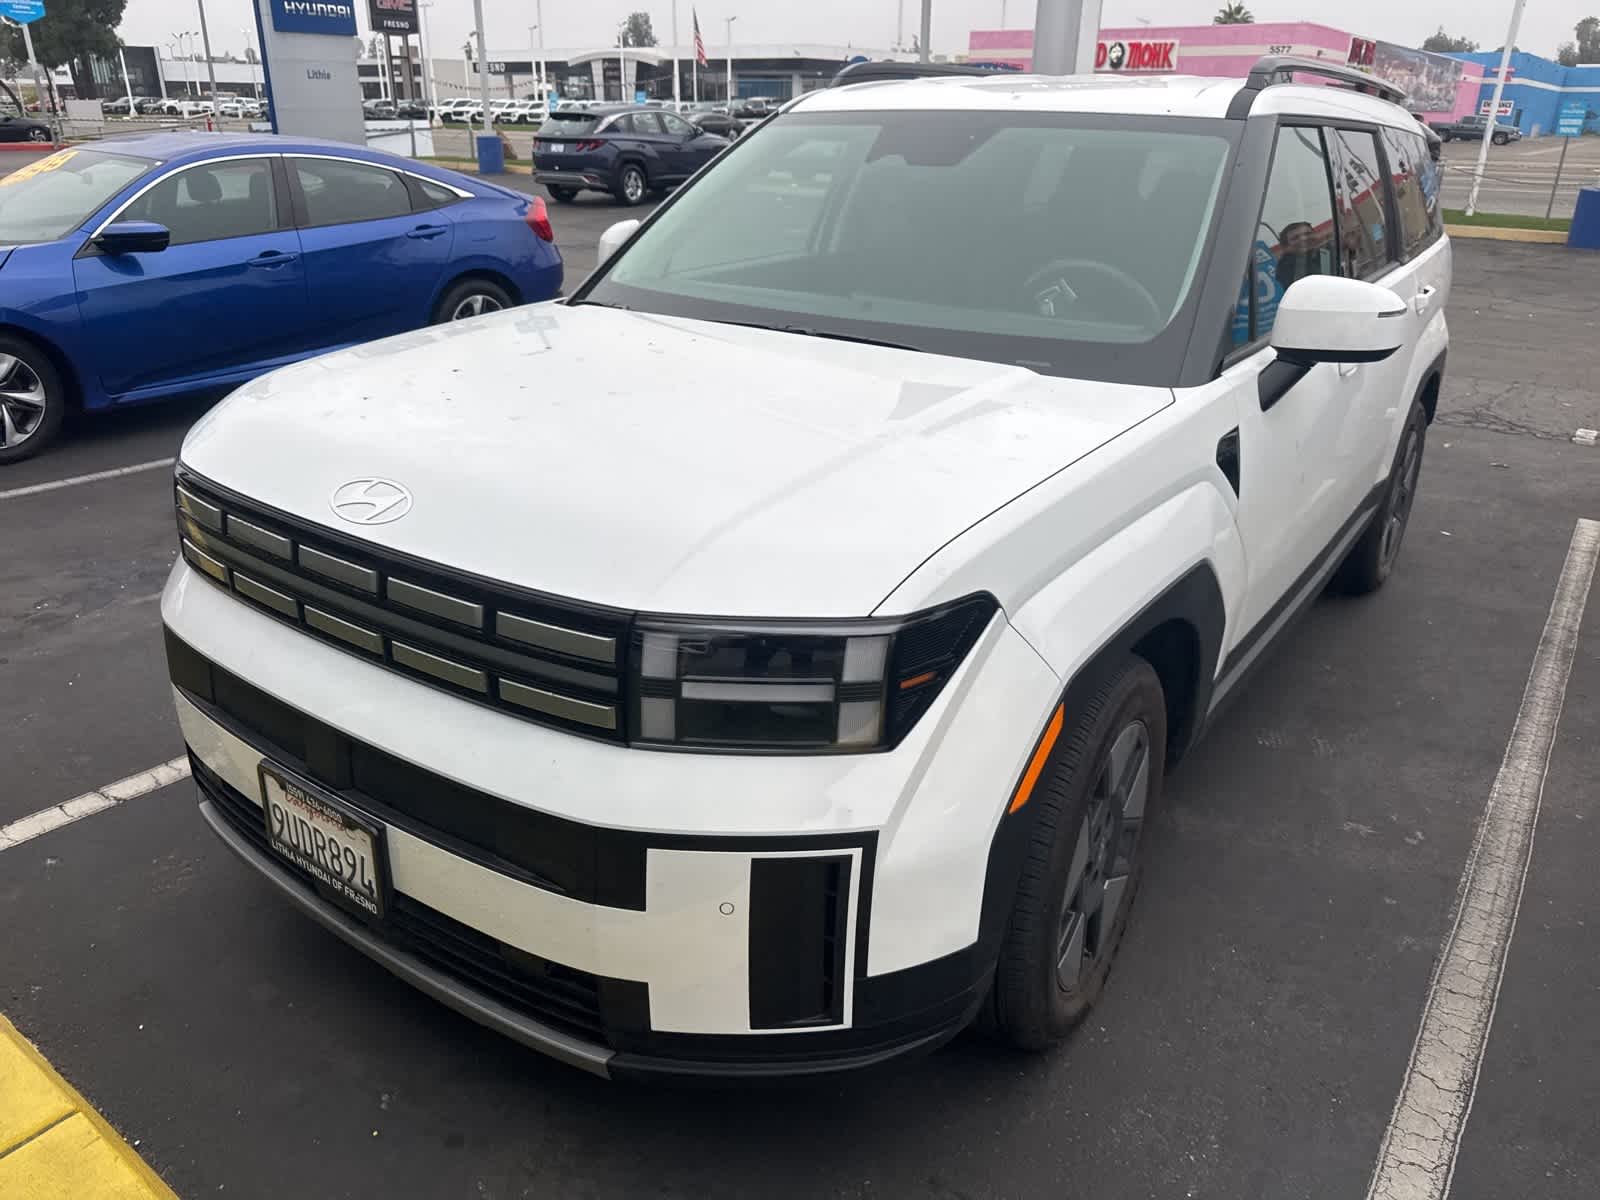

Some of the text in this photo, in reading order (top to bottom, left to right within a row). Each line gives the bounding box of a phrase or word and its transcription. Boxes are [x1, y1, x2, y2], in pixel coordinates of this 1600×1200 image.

[284, 1, 351, 18] HYUNDAI
[383, 20, 410, 29] FRESNO
[1125, 42, 1175, 69] MONK
[1269, 45, 1293, 54] 5577
[307, 69, 331, 80] Lithia
[272, 801, 375, 900] 9UDR894
[271, 839, 378, 915] LITHIA HYUNDAI OF FRESNO
